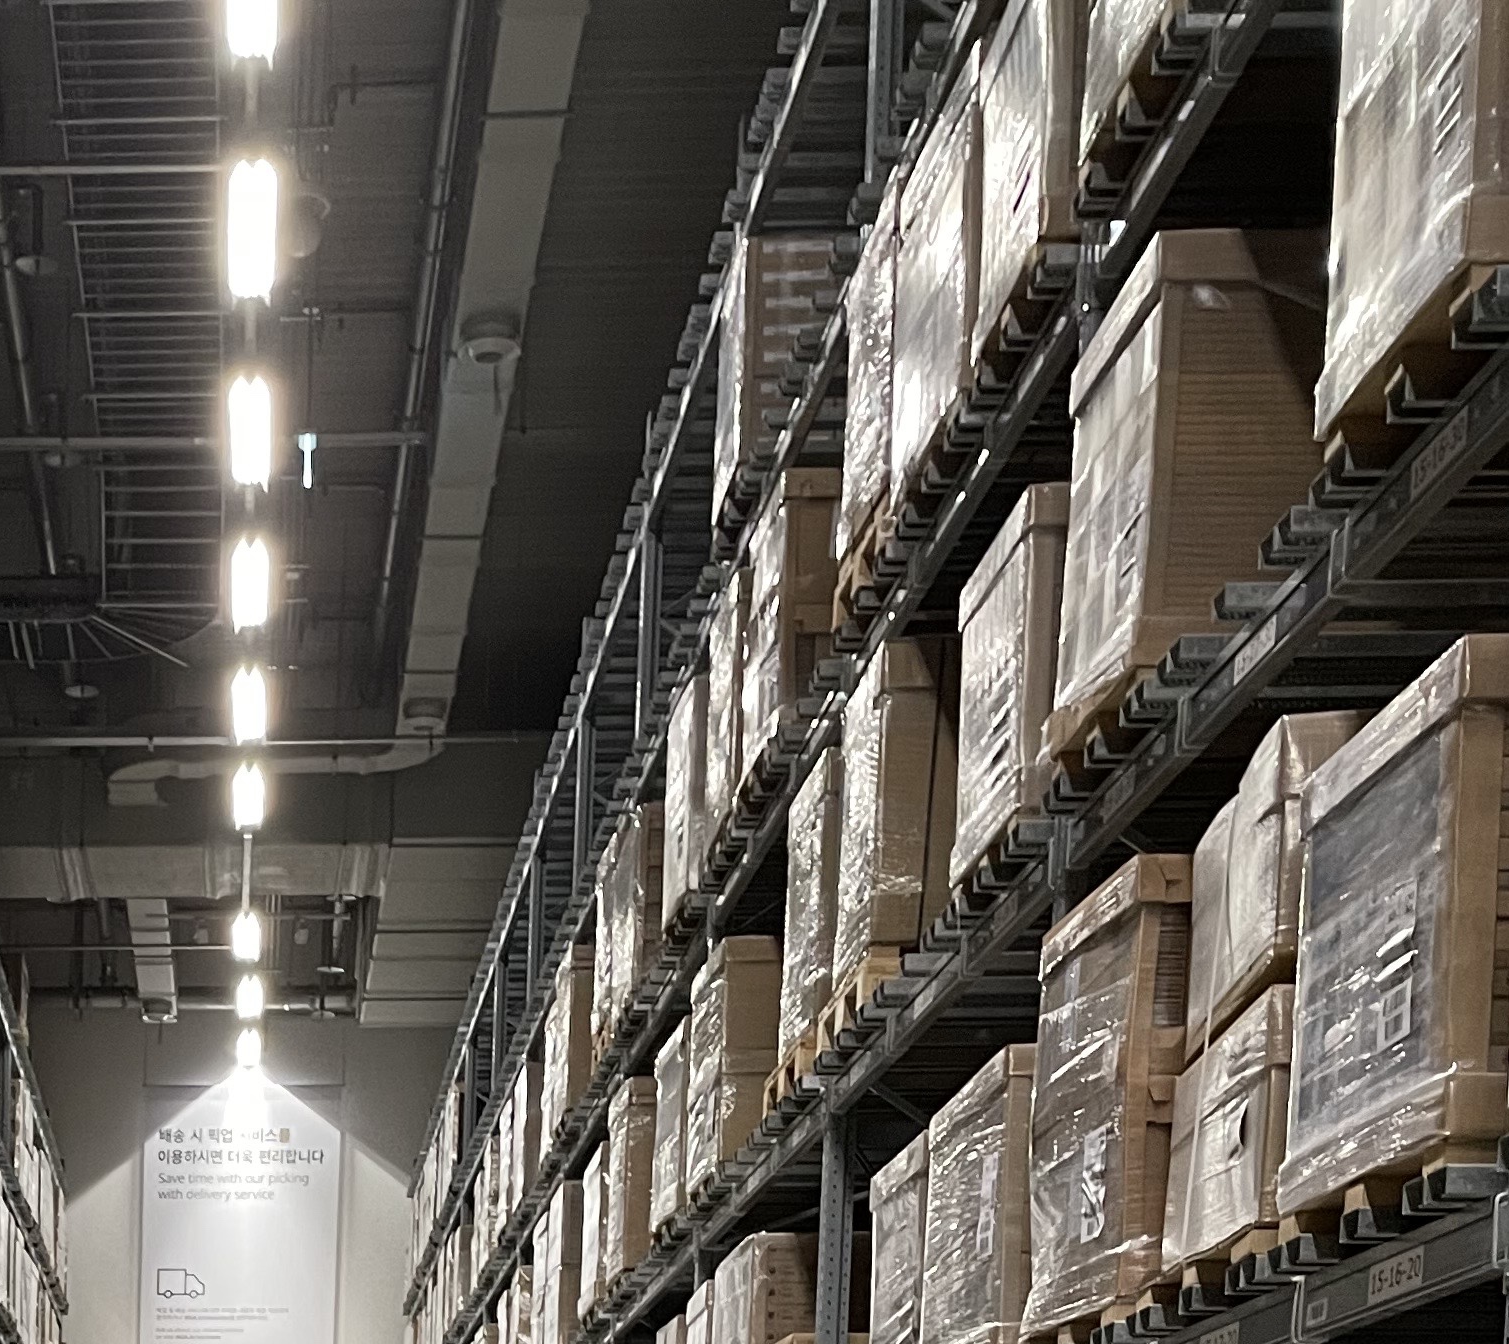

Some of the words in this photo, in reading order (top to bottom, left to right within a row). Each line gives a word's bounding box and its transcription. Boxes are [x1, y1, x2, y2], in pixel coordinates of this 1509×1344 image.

[158, 1128, 185, 1143] 배송
[158, 1150, 223, 1165] 이용하시면
[259, 1149, 325, 1165] 편리합니다
[158, 1172, 186, 1184] Save
[188, 1172, 214, 1184] time
[268, 1172, 310, 1187] picking
[158, 1188, 183, 1200] with
[186, 1188, 232, 1202] delivery
[235, 1189, 275, 1200] service
[1371, 1254, 1422, 1296] 15-16-20
